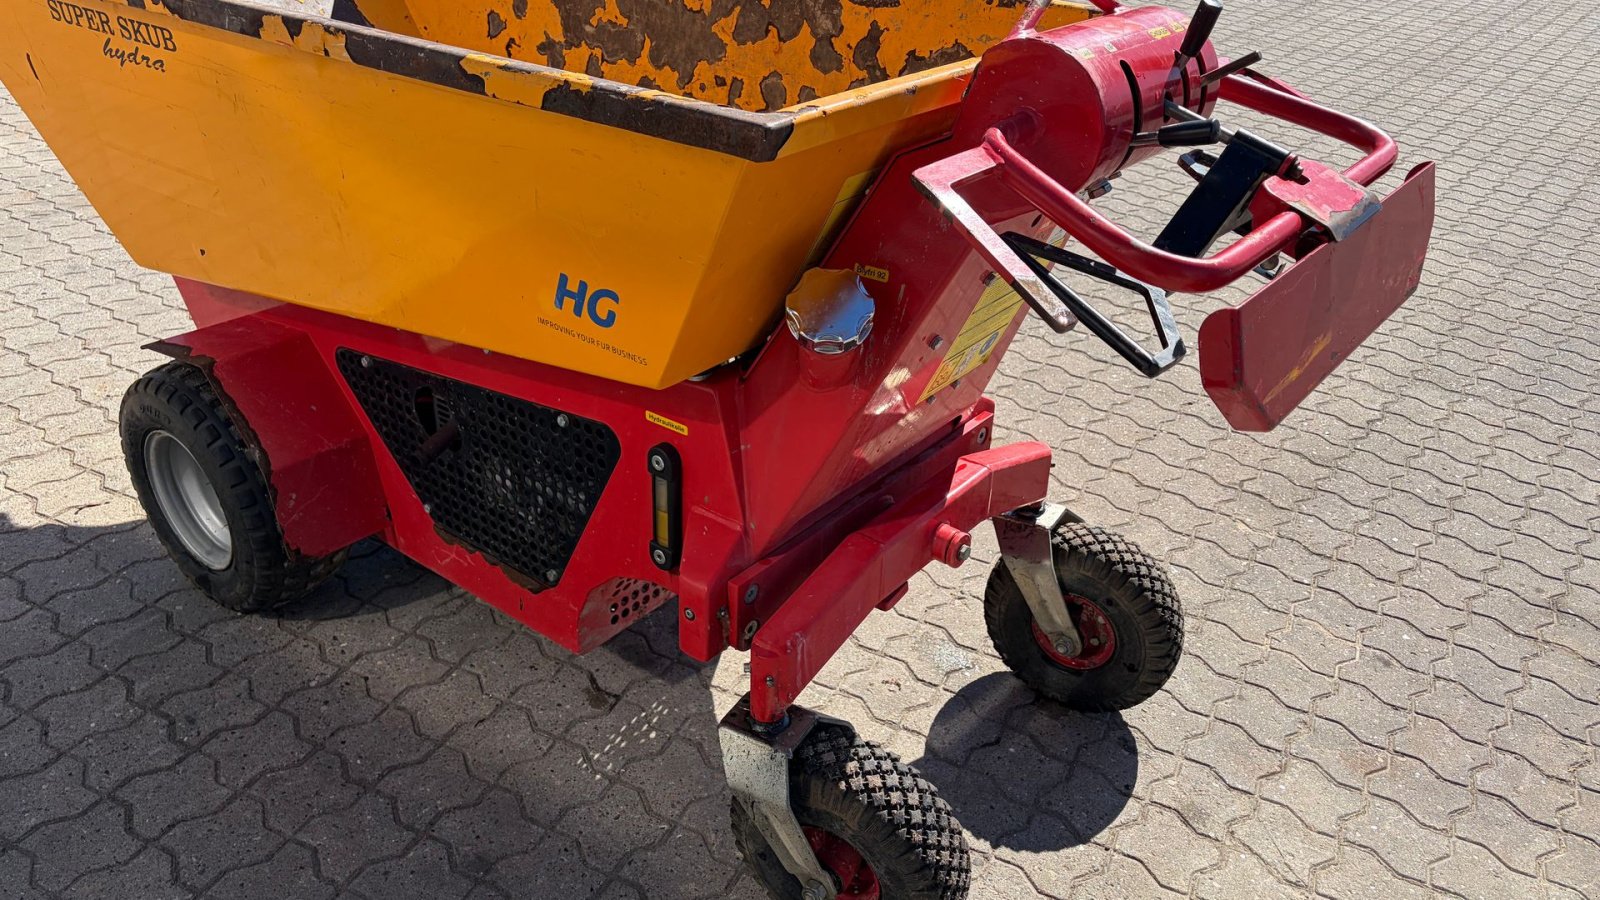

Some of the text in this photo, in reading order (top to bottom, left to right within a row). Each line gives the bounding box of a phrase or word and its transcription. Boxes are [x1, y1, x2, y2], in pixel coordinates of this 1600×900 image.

[47, 0, 177, 52] SUPER SKUB
[103, 37, 166, 73] hydra
[554, 272, 620, 328] HG
[877, 270, 886, 280] 92
[537, 316, 648, 366] IMPROVING YOUR FUR BUSINESS
